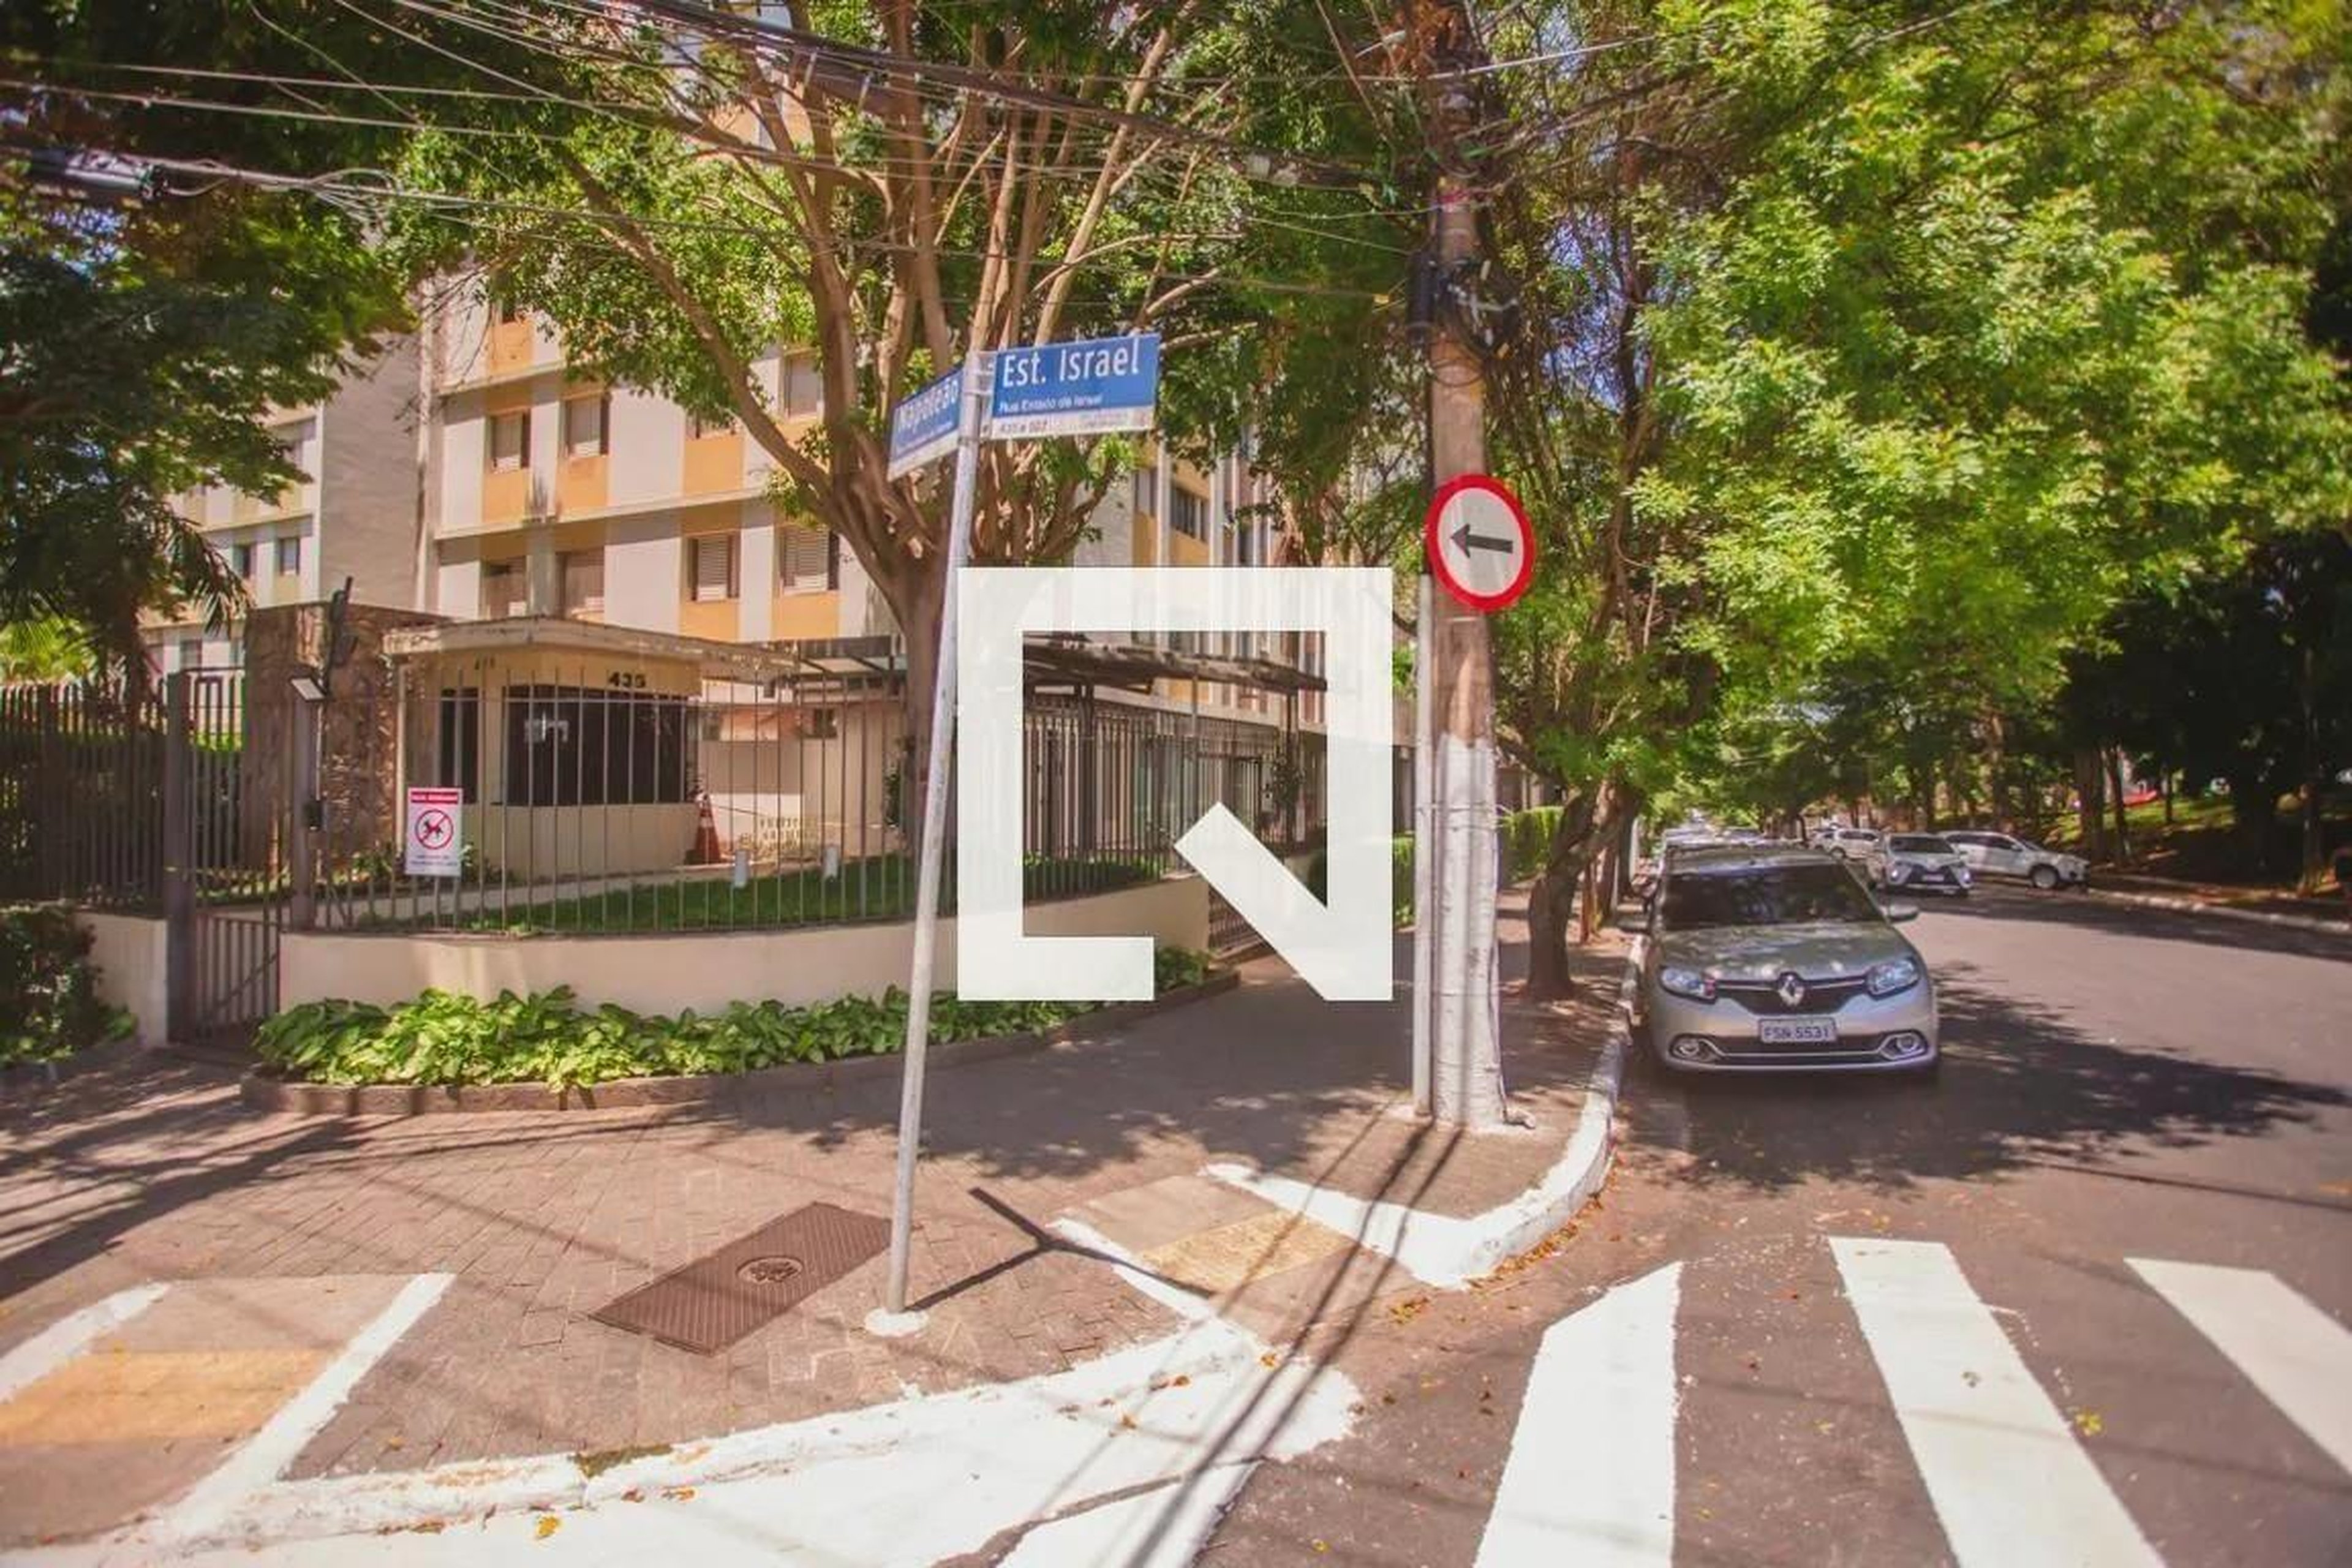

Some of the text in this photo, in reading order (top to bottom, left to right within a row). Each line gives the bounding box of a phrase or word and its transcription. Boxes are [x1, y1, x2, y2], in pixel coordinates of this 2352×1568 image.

[1002, 337, 1140, 388] Est. Israel
[1795, 1025, 1828, 1039] 5531
